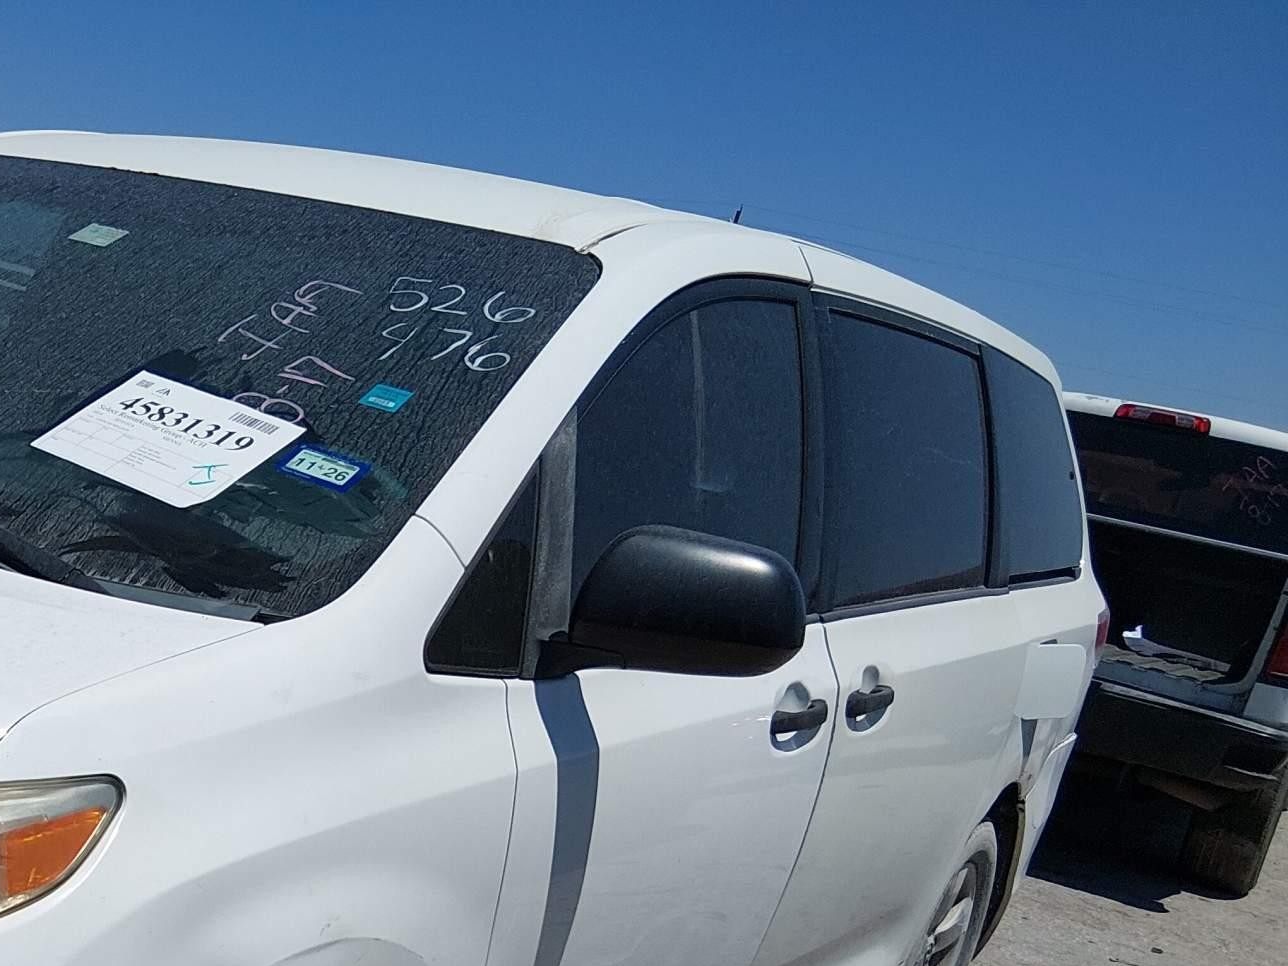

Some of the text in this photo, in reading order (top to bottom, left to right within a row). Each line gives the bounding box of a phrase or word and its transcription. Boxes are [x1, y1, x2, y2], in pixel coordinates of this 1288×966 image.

[389, 276, 537, 323] 526
[377, 322, 512, 372] 476
[119, 397, 255, 451] 45831319
